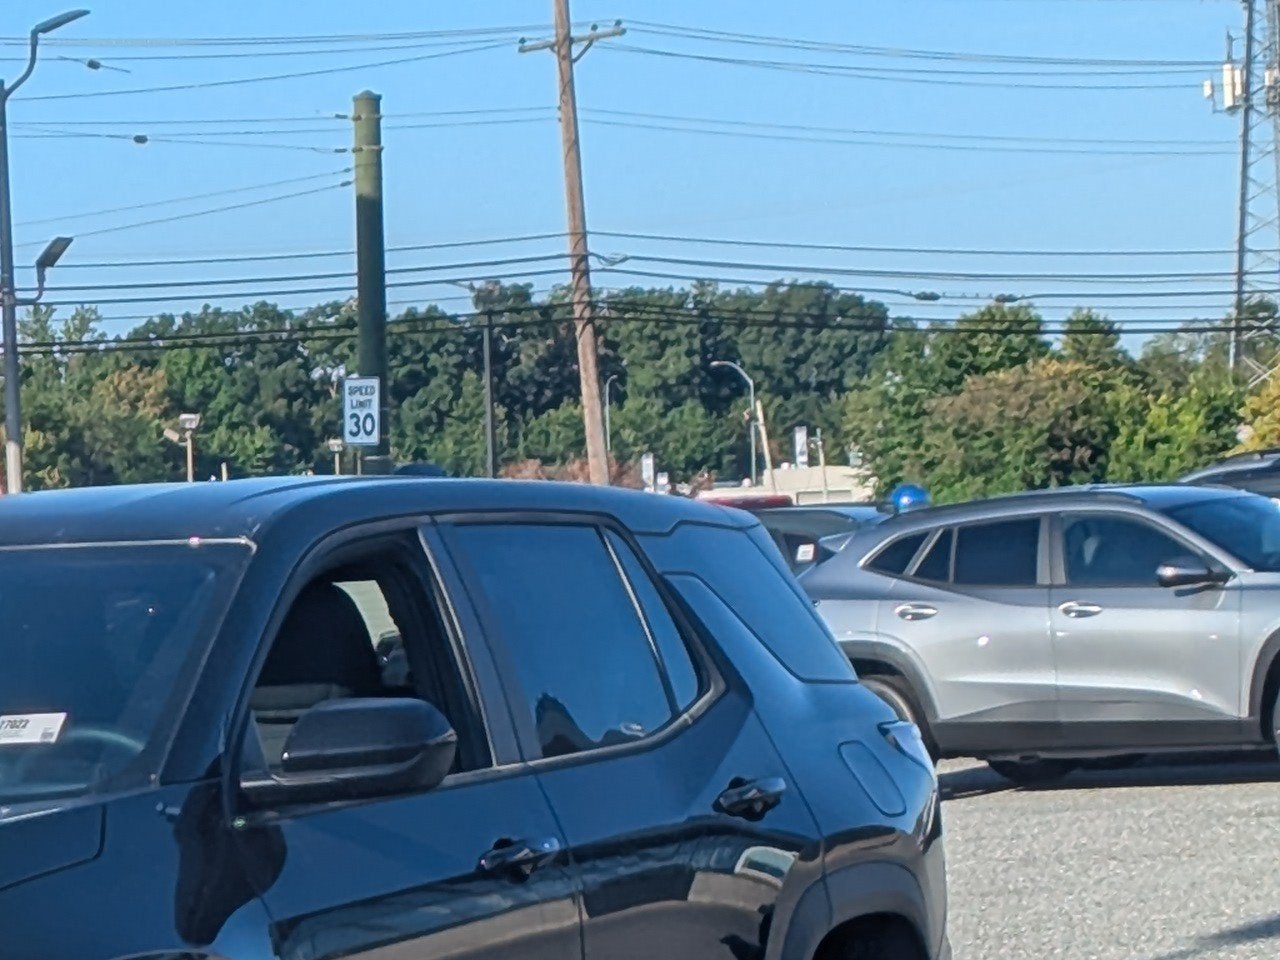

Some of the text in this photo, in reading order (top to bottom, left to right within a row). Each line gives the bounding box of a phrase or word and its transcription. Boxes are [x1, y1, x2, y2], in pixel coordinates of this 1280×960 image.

[348, 385, 376, 396] SPEED
[350, 399, 373, 409] LIMIT
[349, 412, 375, 437] 30
